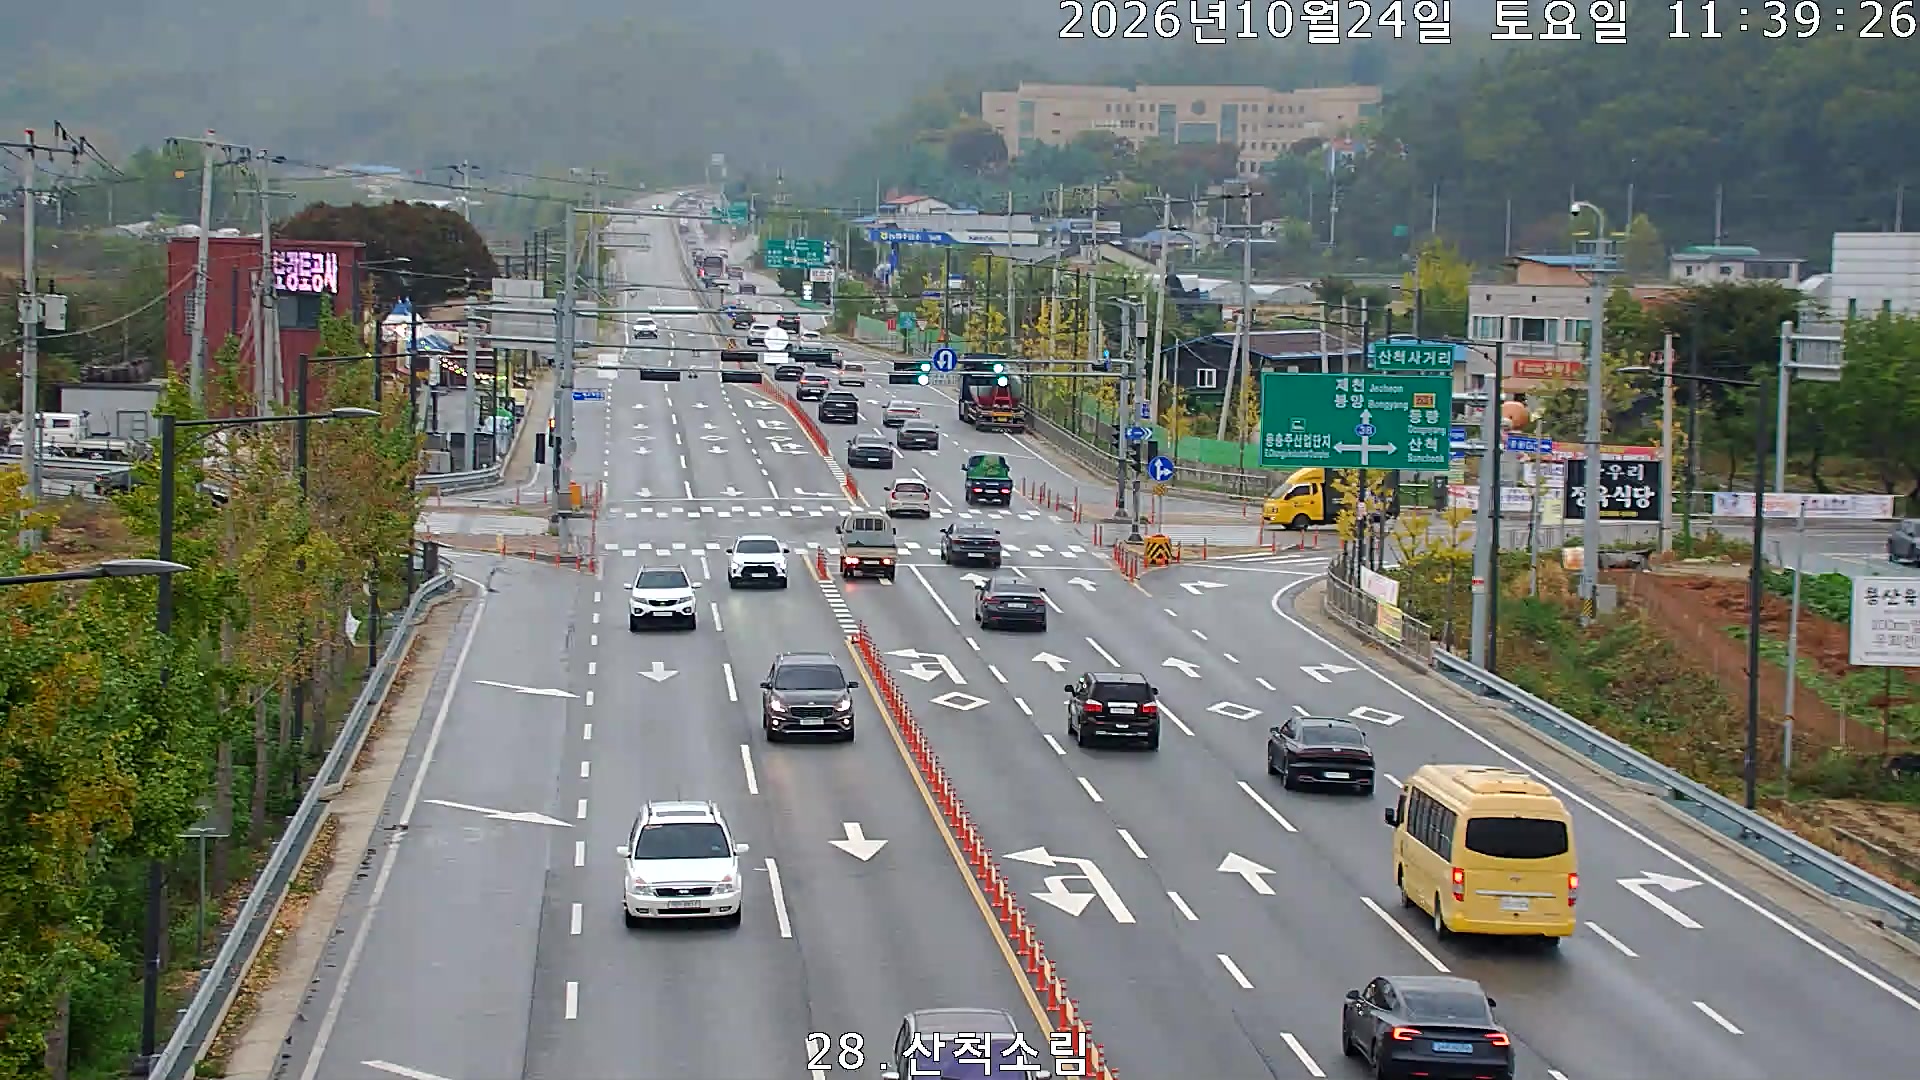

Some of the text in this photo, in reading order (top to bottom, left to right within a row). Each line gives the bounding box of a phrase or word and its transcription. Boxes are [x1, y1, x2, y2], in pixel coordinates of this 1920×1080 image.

[1377, 349, 1452, 366] 산척사거리
[1335, 377, 1365, 393] 제천
[1334, 394, 1364, 409] 봉양
[1359, 426, 1373, 436] 38
[1408, 437, 1439, 453] 산척
